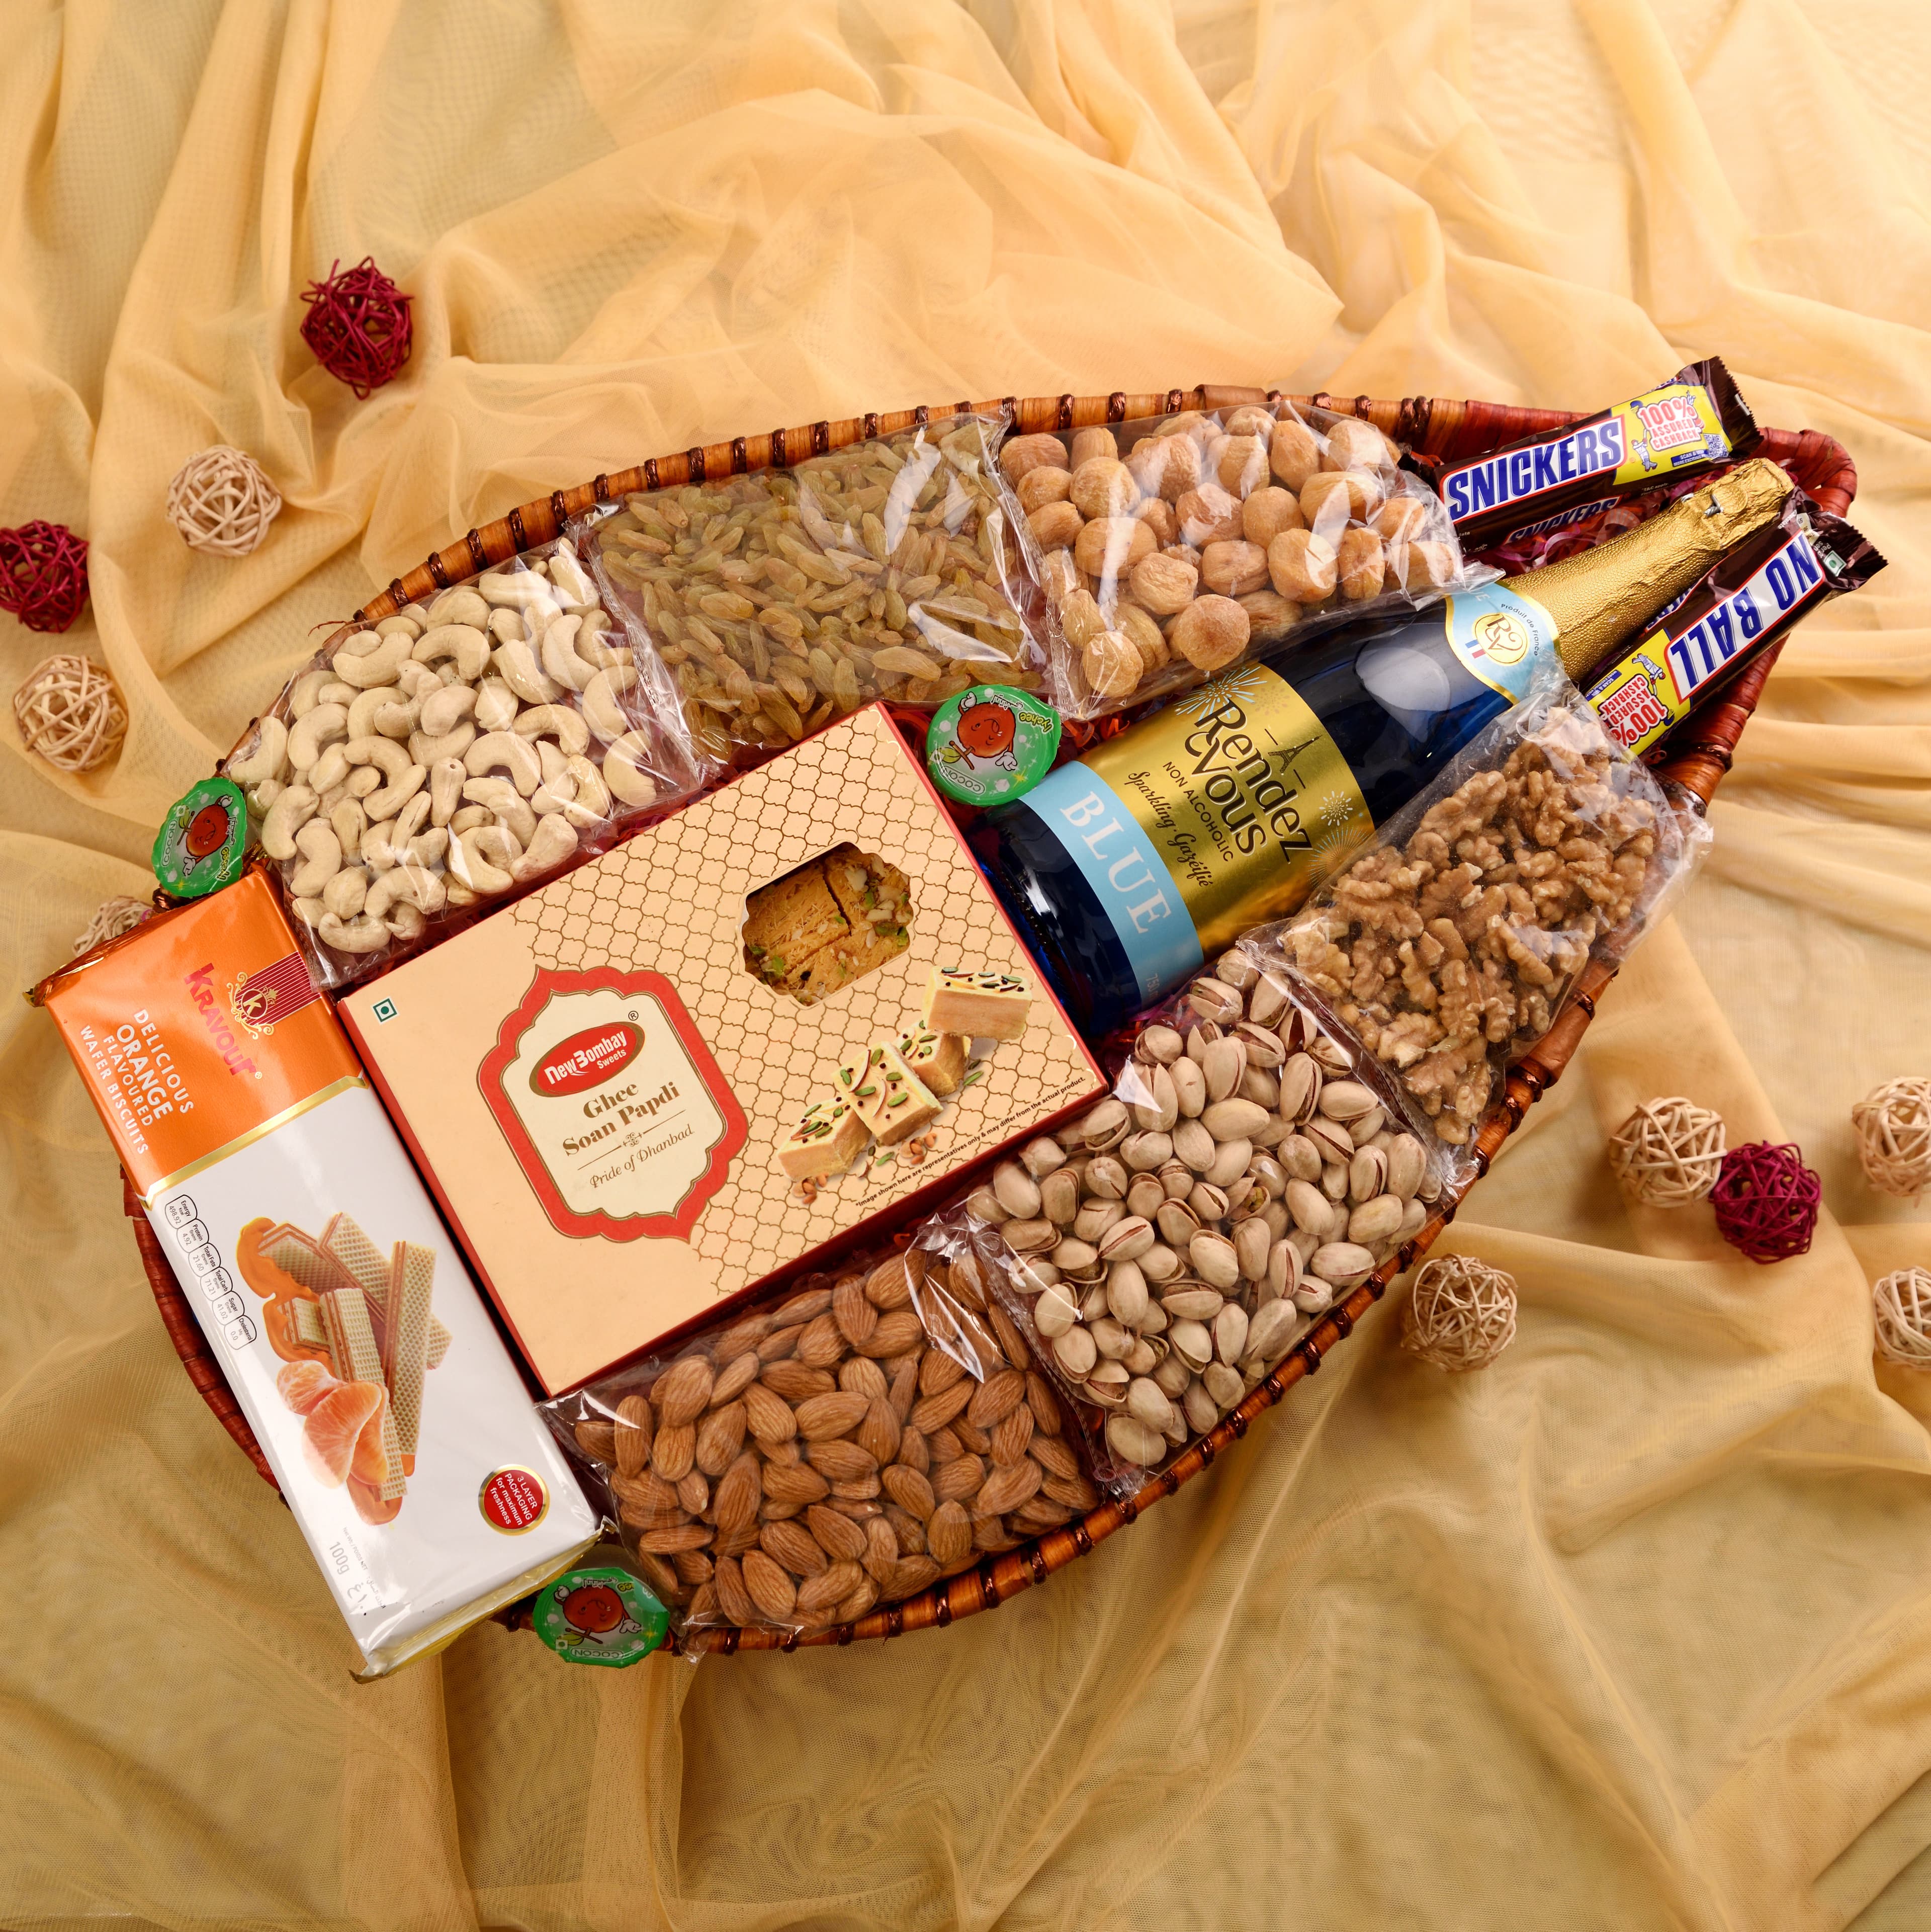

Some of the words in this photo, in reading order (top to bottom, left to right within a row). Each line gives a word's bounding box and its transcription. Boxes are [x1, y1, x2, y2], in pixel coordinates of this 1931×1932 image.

[1640, 398, 1696, 428] 100%
[1651, 419, 1694, 438] ASSURED
[1652, 429, 1699, 449] CASHBACK
[1448, 422, 1623, 521] SNICKERS
[1765, 534, 1820, 610] NO
[1501, 604, 1527, 619] Produit
[1527, 619, 1534, 628] de
[1670, 587, 1764, 689] BALL
[1602, 677, 1646, 716] CASHBACK
[1605, 677, 1614, 688] SCAN
[1610, 689, 1650, 725] ASSURED
[1611, 698, 1665, 746] 100%
[940, 767, 982, 792] COCON
[1184, 730, 1268, 858] Vous
[1194, 697, 1313, 865] Rendez
[1123, 771, 1176, 830] Sparkling
[1167, 832, 1214, 888] Gazéifié
[1163, 761, 1188, 788] NON
[1183, 789, 1235, 863] ALCOHOLIC
[163, 822, 176, 863] COCON
[1060, 791, 1172, 934] BLUE
[133, 1009, 194, 1114] DELICIOUS
[574, 1030, 628, 1069] Bombay
[596, 1049, 627, 1070] Sweets
[80, 1025, 112, 1080] WAFER
[107, 1083, 149, 1154] BISCUITS
[103, 1035, 153, 1127] FLAVOURED
[116, 1024, 173, 1120] ORANGE
[562, 1121, 617, 1156] Soan
[617, 1081, 680, 1126] Papdi
[583, 1083, 639, 1119] Ghee
[877, 1183, 899, 1199] shown
[898, 1173, 912, 1186] here
[911, 1168, 922, 1178] are
[922, 1141, 968, 1171] representatives
[967, 1135, 982, 1149] only
[986, 1124, 1000, 1140] may
[1000, 1115, 1017, 1128] differ
[1015, 1106, 1032, 1120] from
[1030, 1101, 1042, 1111] the
[1040, 1089, 1060, 1106] actual
[1060, 1076, 1086, 1098] product.
[590, 1165, 623, 1189] Pride
[624, 1155, 636, 1172] of
[636, 1123, 694, 1163] Dhanbad
[169, 1205, 182, 1225] 498.92
[181, 1200, 192, 1217] Energy
[182, 1233, 192, 1246] 4.92
[193, 1224, 203, 1241] Protein
[193, 1255, 205, 1272] 21.60
[203, 1246, 213, 1258] Total
[208, 1256, 216, 1268] Fats
[205, 1279, 216, 1296] 71.21
[215, 1270, 224, 1281] Total
[219, 1280, 228, 1292] Carb
[217, 1303, 228, 1320] 41.02
[228, 1297, 238, 1313] Sugar
[230, 1331, 238, 1341] 0.0
[238, 1317, 253, 1341] Cholesterol
[490, 1487, 511, 1525] freshness
[496, 1477, 505, 1489] for
[502, 1490, 523, 1525] maximum
[505, 1473, 533, 1520] PACKAGING
[520, 1482, 538, 1508] LAYER
[329, 1541, 350, 1575] 100g
[574, 1649, 620, 1659] COCON
